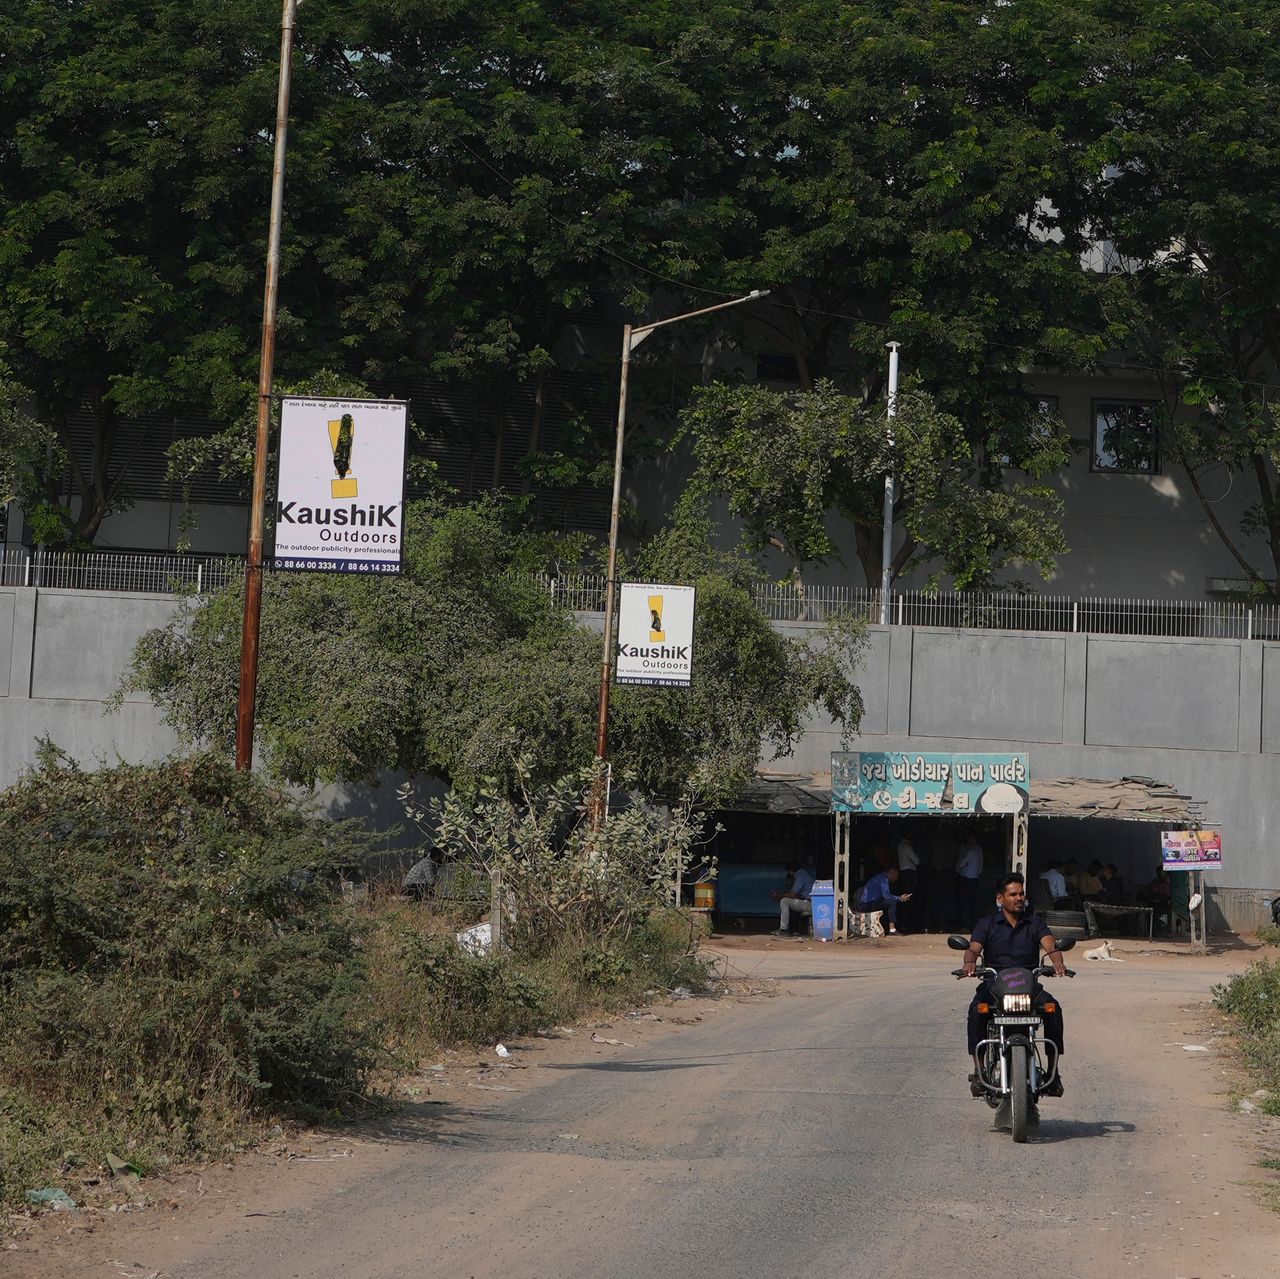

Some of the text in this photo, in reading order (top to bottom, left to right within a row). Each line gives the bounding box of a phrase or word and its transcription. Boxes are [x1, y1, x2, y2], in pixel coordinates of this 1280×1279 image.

[277, 501, 397, 527] KaushiK
[320, 529, 397, 544] Outdoors
[321, 545, 352, 553] publicity
[284, 560, 294, 568] 88
[295, 561, 305, 569] 66
[307, 561, 317, 569] 00
[318, 561, 337, 570] 3334
[348, 562, 358, 571] 88
[359, 563, 369, 571] 66
[371, 563, 380, 571] 14
[381, 564, 400, 572] 3334
[617, 643, 689, 660] KaushiK
[642, 659, 688, 670] Outdoors
[862, 756, 1026, 783] જય ખોડીયાર પાન પાર્લર
[897, 785, 917, 810] ટી
